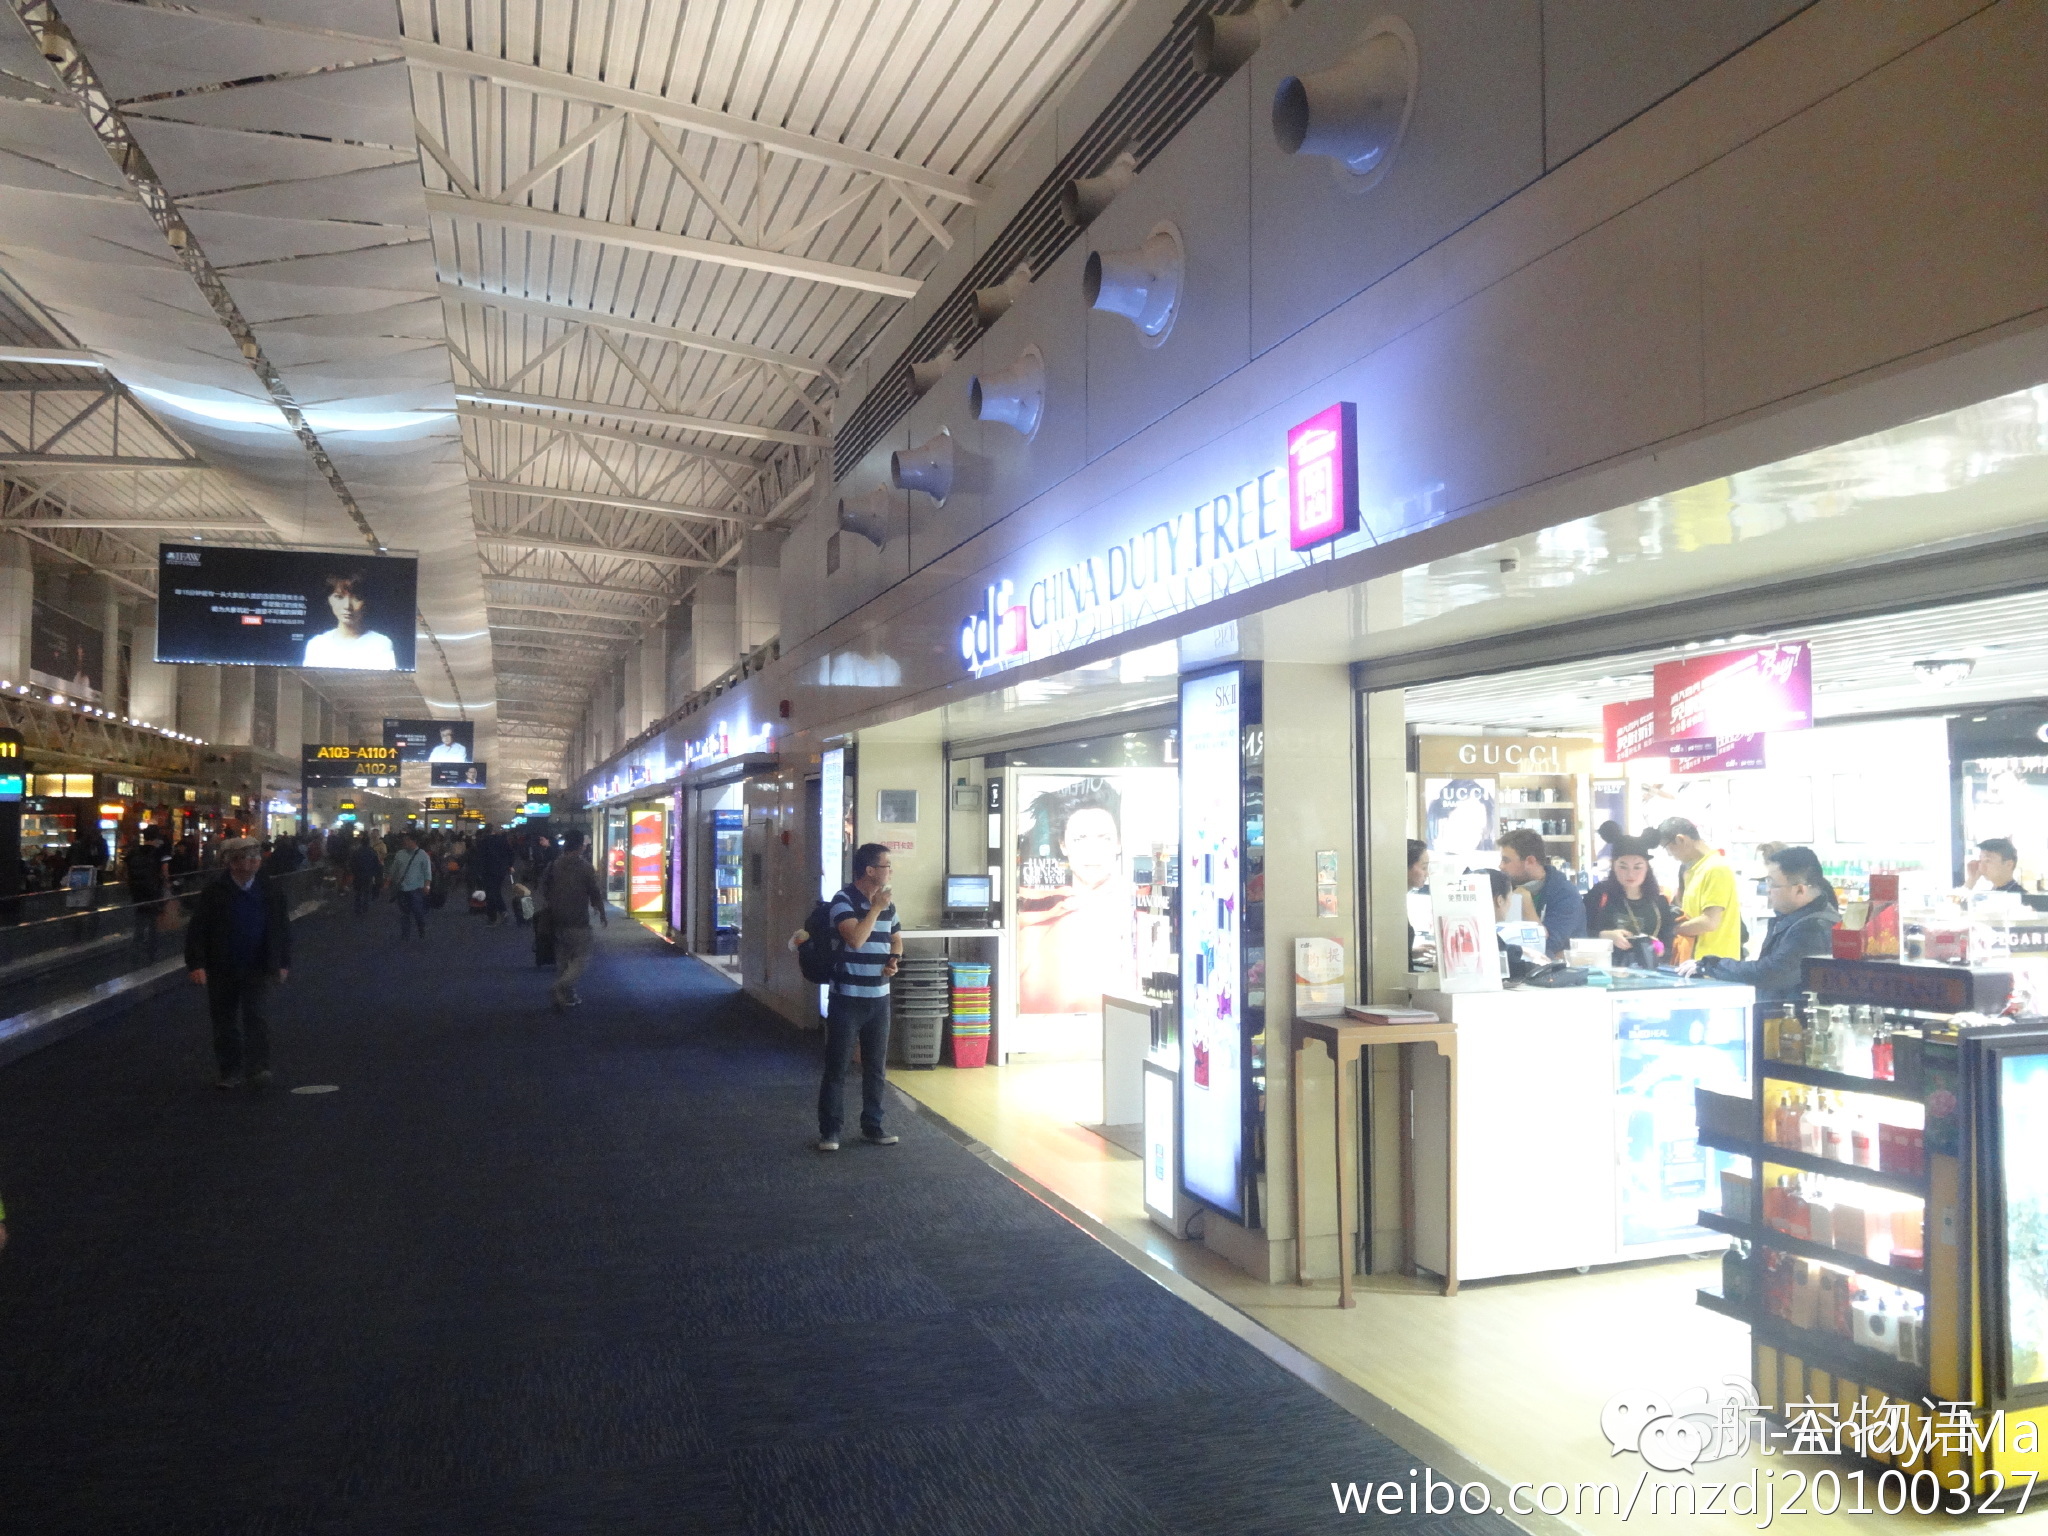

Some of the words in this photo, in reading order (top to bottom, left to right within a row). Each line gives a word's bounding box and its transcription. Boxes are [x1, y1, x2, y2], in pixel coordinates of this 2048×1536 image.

[1030, 557, 1101, 630] CHINA
[1108, 515, 1183, 600] DUTY
[1195, 467, 1283, 568] FREE
[1215, 683, 1237, 707] SK-II
[1458, 743, 1559, 765] GUCCI
[355, 763, 387, 774] A102
